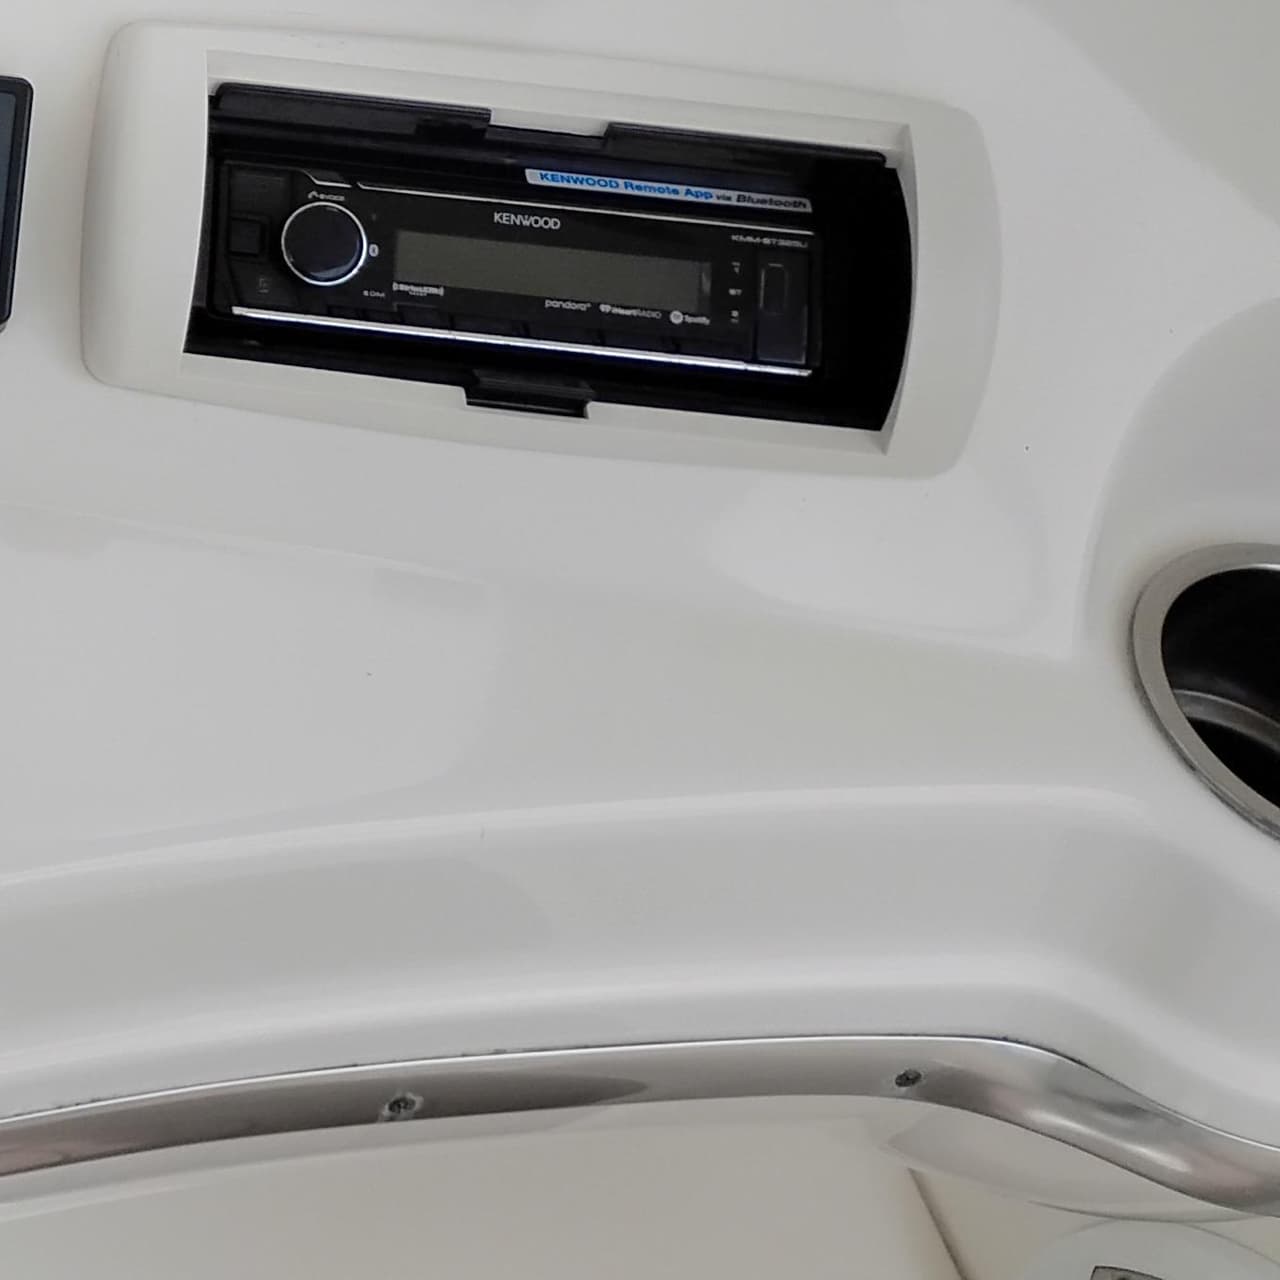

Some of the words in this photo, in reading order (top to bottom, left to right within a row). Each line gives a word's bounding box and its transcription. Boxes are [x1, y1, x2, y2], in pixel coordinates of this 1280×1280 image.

[539, 172, 620, 190] KENWOOD
[623, 181, 680, 197] Remote
[684, 188, 714, 201] App
[493, 211, 561, 230] KENWOOD
